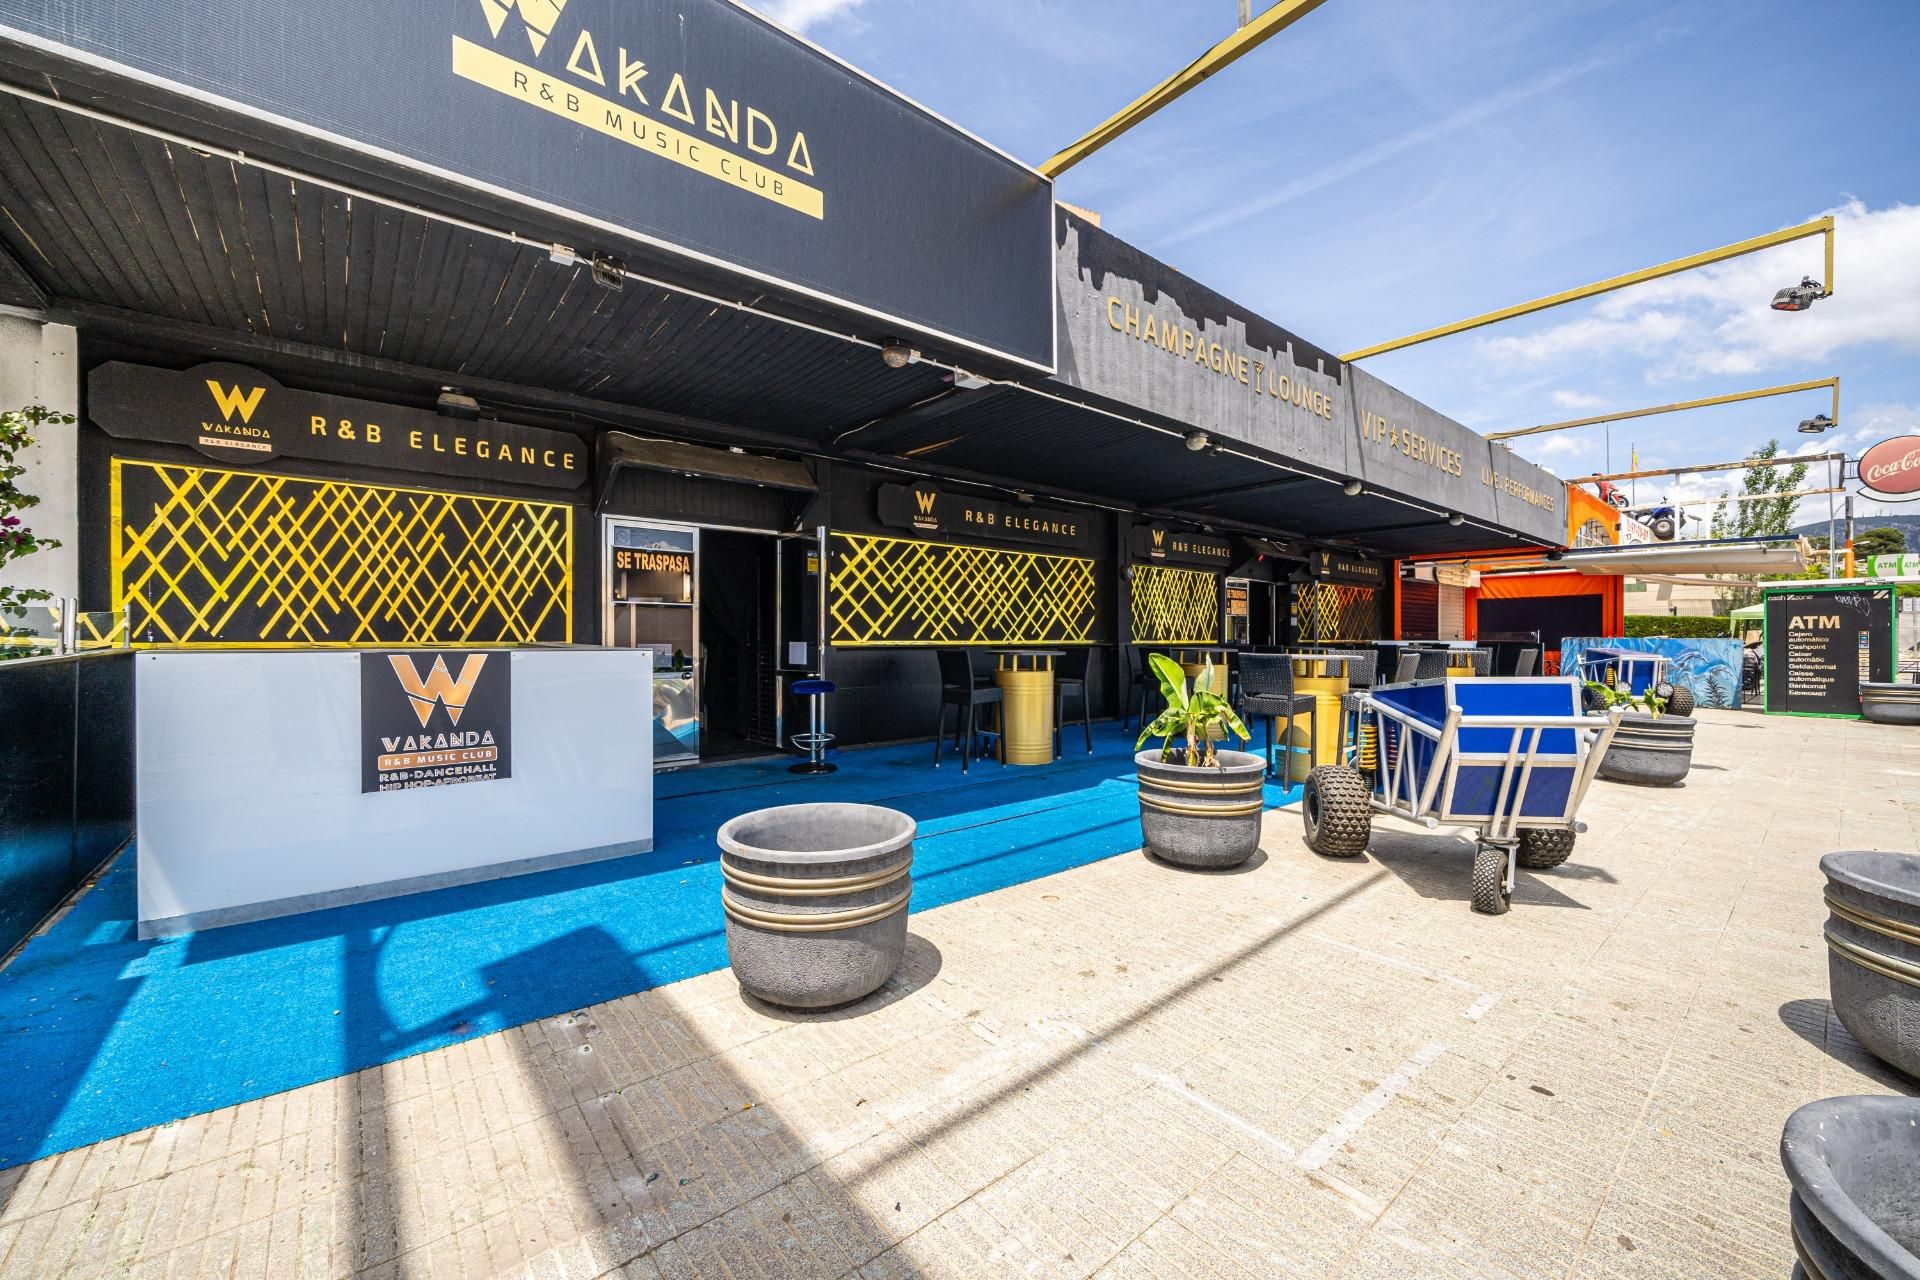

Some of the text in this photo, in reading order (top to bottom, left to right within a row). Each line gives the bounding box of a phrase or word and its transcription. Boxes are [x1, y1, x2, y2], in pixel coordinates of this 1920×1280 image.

[513, 71, 785, 197] R&B MUSIC CLUB
[1107, 296, 1333, 420] CHAMPAGNE LOUNGE
[202, 421, 270, 439] WAKANDA
[204, 438, 268, 450] R&B ELEGANCE
[311, 415, 575, 470] R&B ELEGANCE
[1361, 409, 1464, 478] VIP SERVICES
[1482, 464, 1555, 513] LIVE PERFORMANCES
[965, 510, 1076, 536] R&B ELEGANCE
[1172, 541, 1231, 558] R&B ELEGANCE
[617, 551, 691, 572] SE TRASPASA
[1337, 563, 1349, 572] R&B
[1351, 565, 1379, 576] ELEGANCE
[1878, 561, 1897, 569] ATM
[1788, 615, 1841, 629] ATM
[381, 730, 495, 753] WAKANDA
[384, 750, 493, 767] R&B MUSIC CLUB
